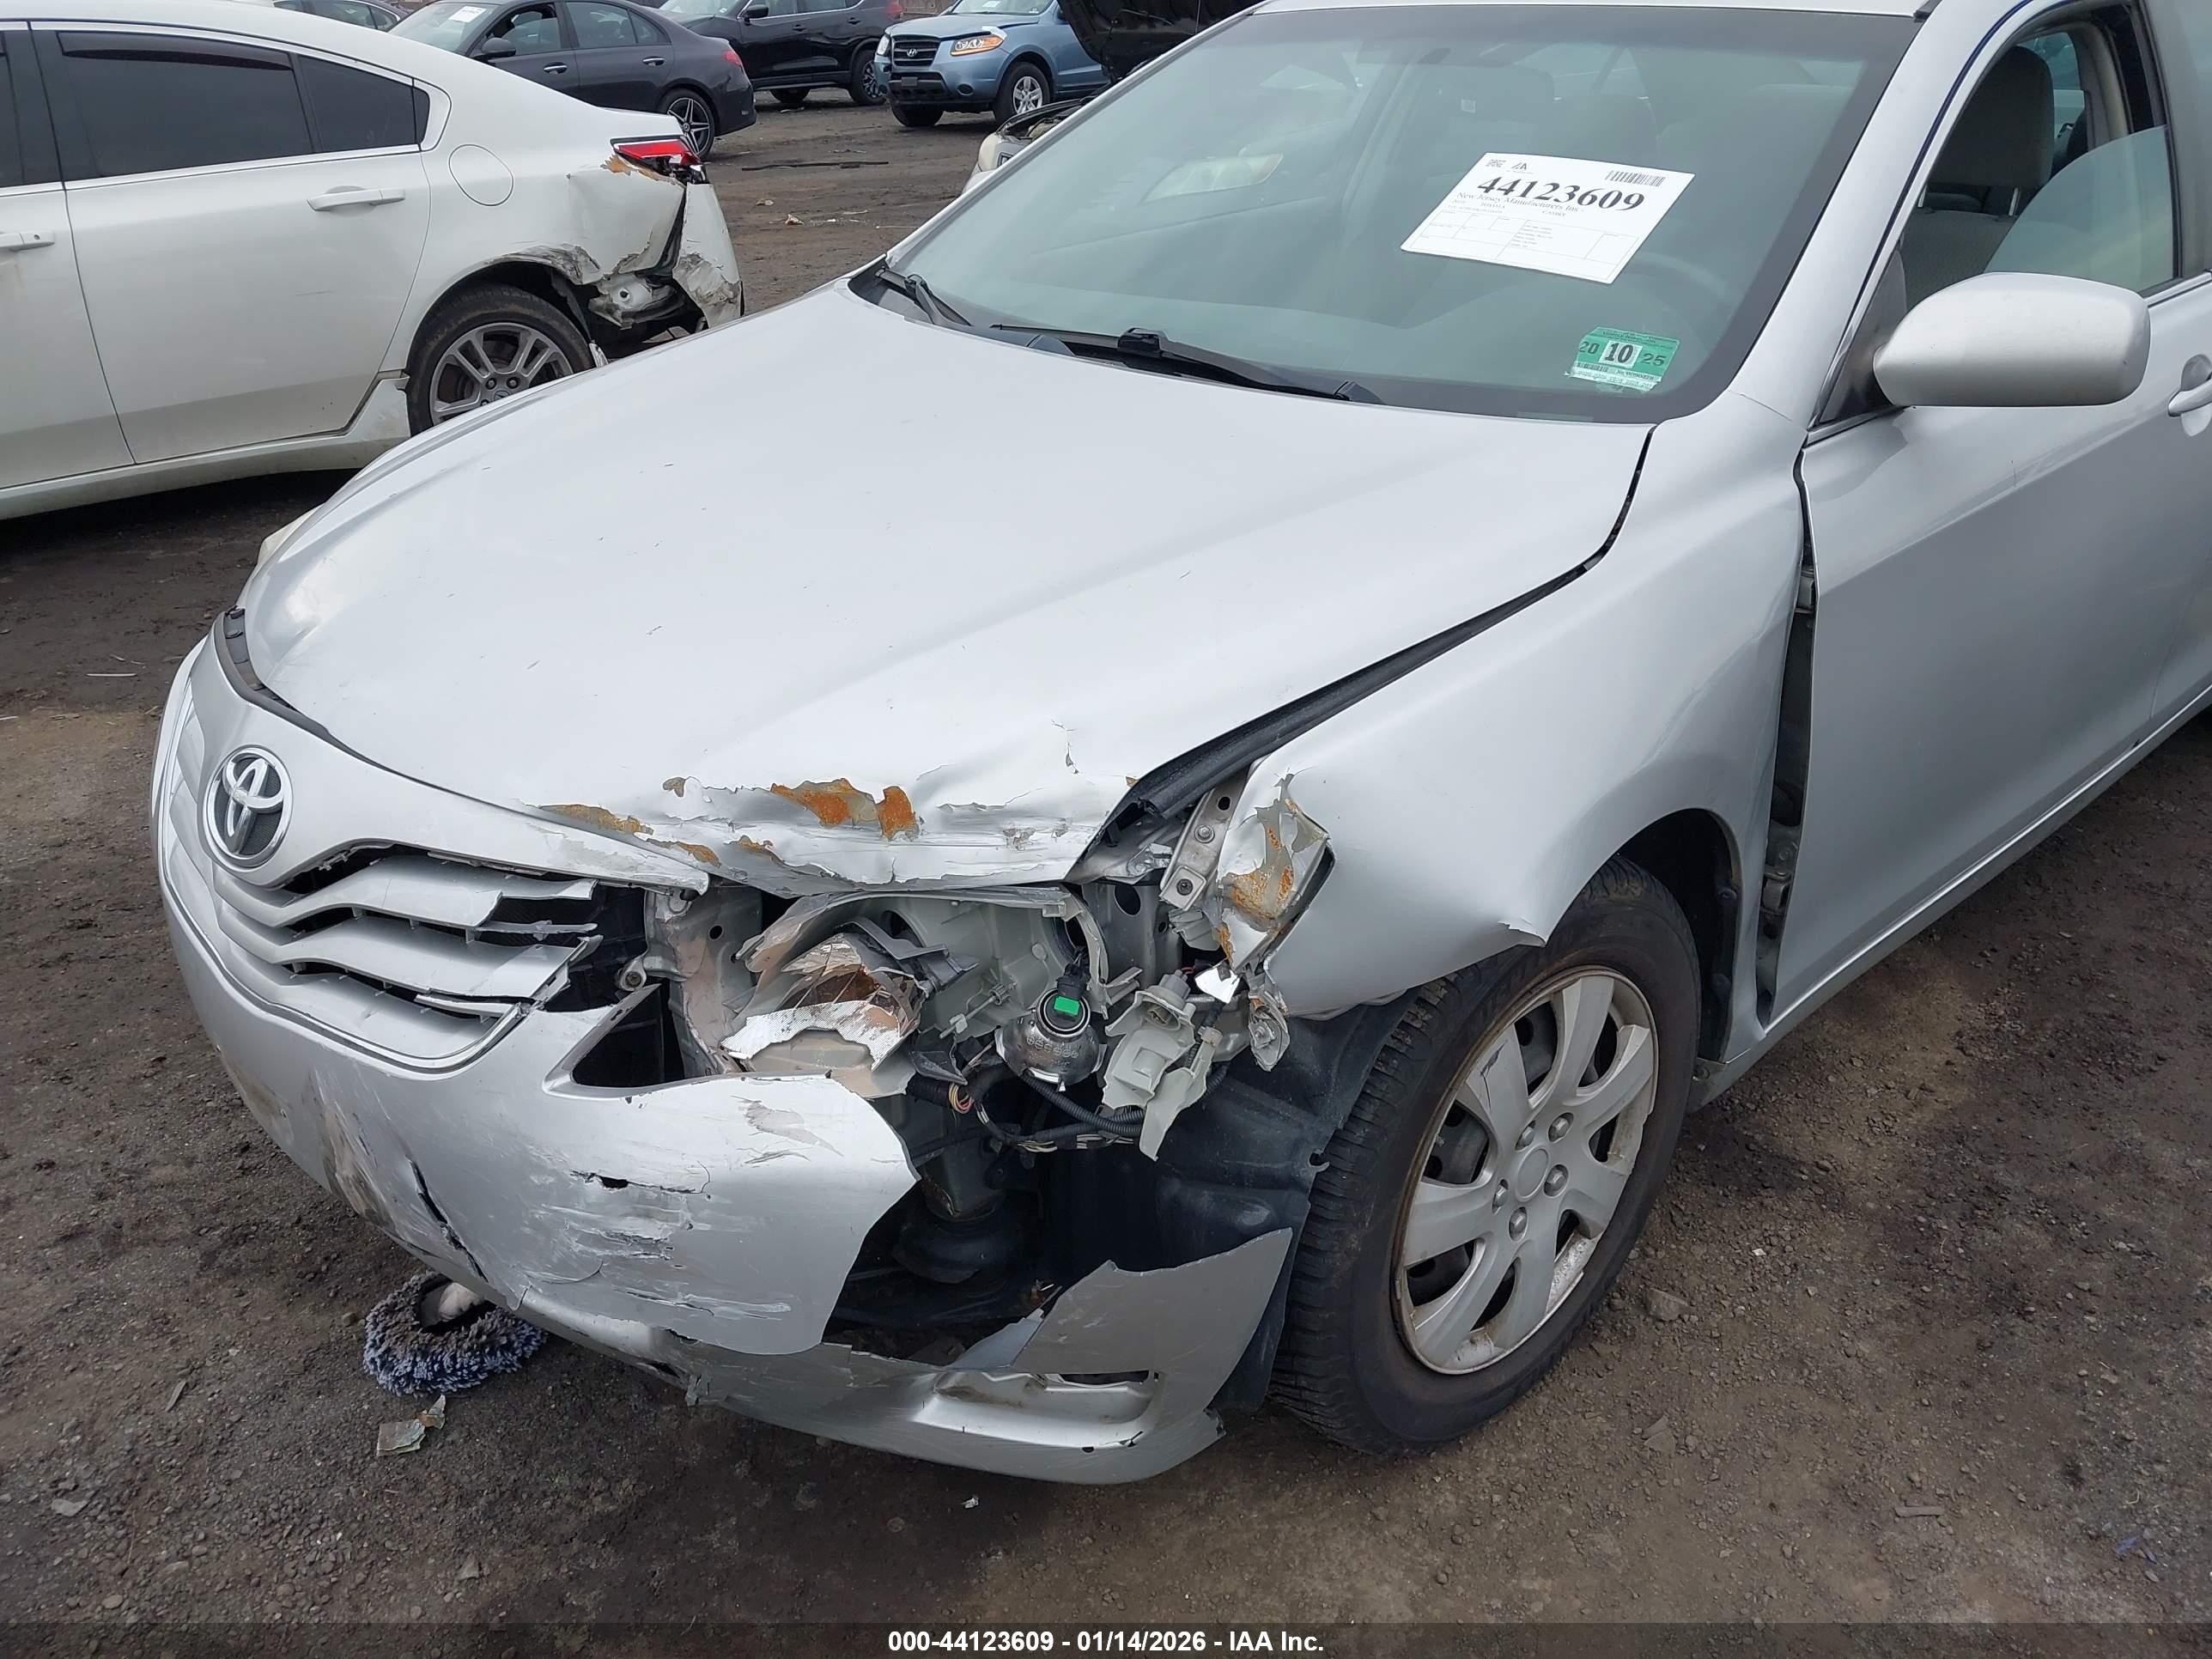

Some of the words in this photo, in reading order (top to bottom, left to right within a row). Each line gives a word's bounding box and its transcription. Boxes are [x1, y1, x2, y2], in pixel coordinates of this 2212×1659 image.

[1477, 176, 1644, 211] 44123609
[1477, 193, 1503, 204] Jersey
[1504, 196, 1564, 210] Manufacturers
[1579, 342, 1599, 355] 20
[1604, 342, 1634, 363] 10
[1642, 353, 1666, 366] 25
